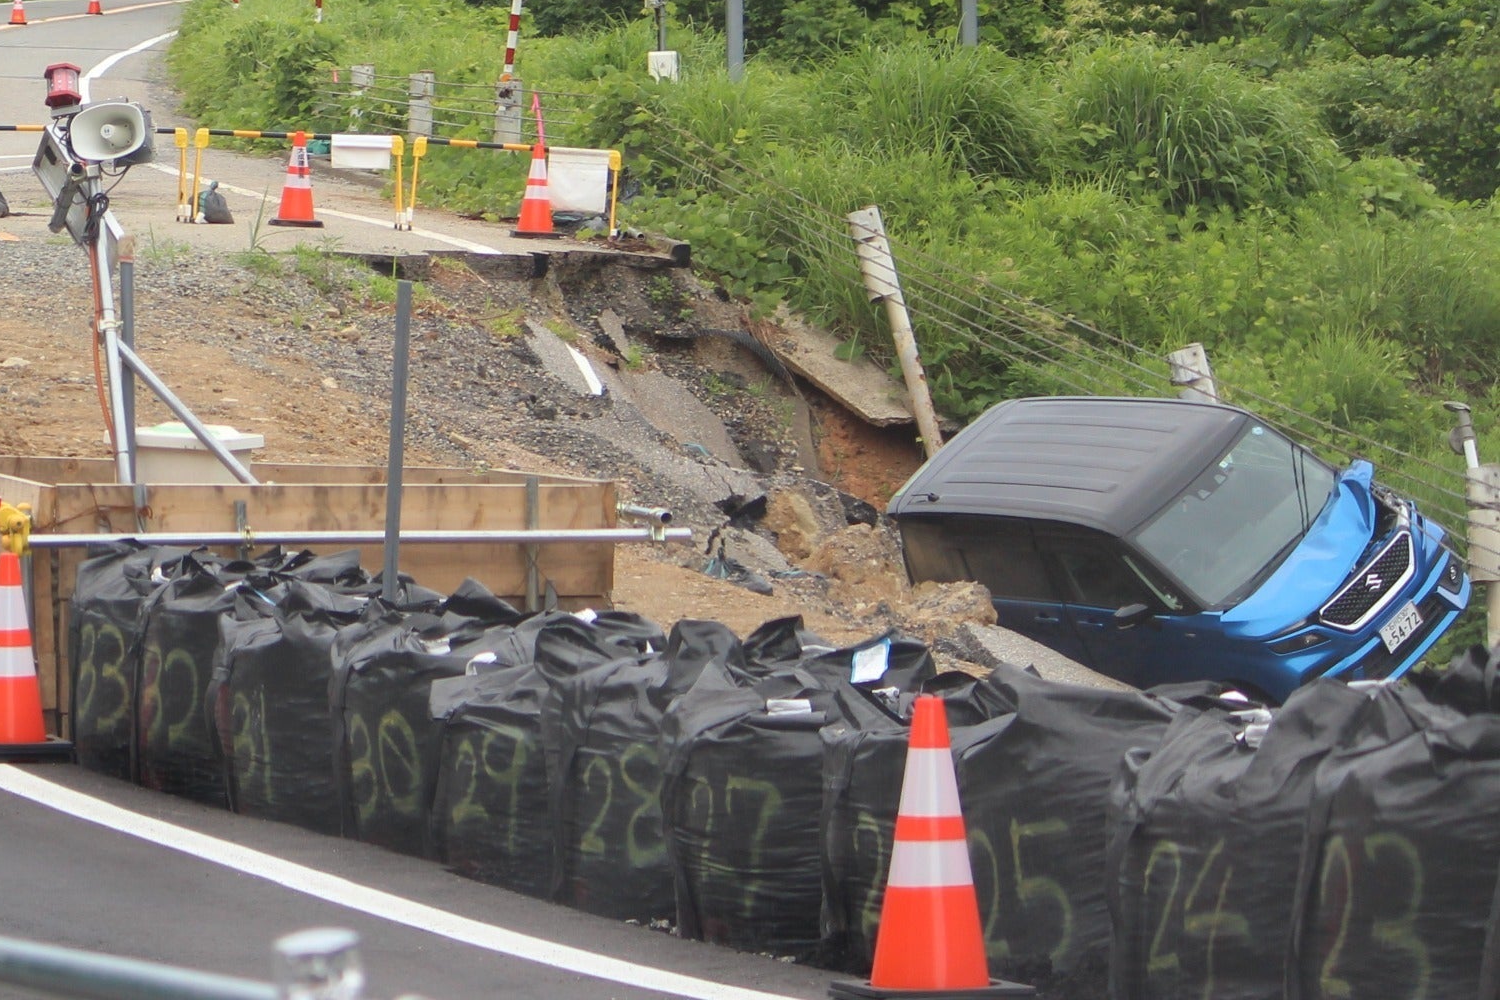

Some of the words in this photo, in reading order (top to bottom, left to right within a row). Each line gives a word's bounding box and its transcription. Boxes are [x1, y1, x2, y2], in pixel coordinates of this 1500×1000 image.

[78, 623, 130, 731] 33
[1391, 611, 1421, 645] 54-72
[451, 727, 526, 855] 29
